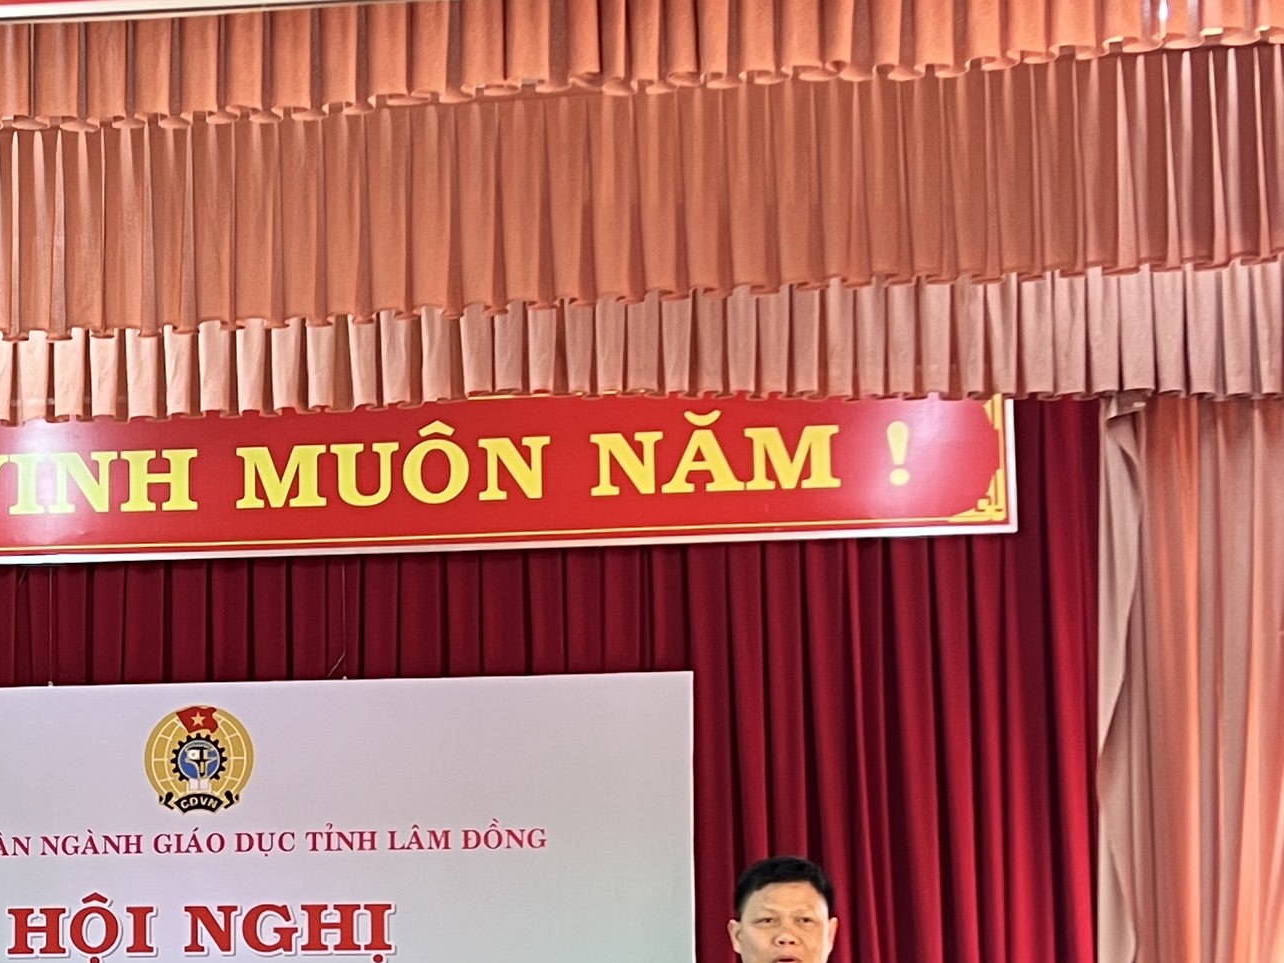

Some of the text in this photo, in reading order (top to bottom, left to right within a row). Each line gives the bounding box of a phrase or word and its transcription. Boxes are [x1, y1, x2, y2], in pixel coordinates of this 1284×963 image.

[235, 421, 550, 509] MUÔN
[589, 410, 841, 496] NĂM
[885, 420, 911, 487] !
[41, 829, 143, 856] NGÀNH
[153, 828, 226, 855] GIÁO
[235, 832, 296, 857] DỤC
[306, 823, 378, 852] TỈNH
[388, 824, 452, 851] LÂM
[462, 818, 548, 850] ĐỒNG
